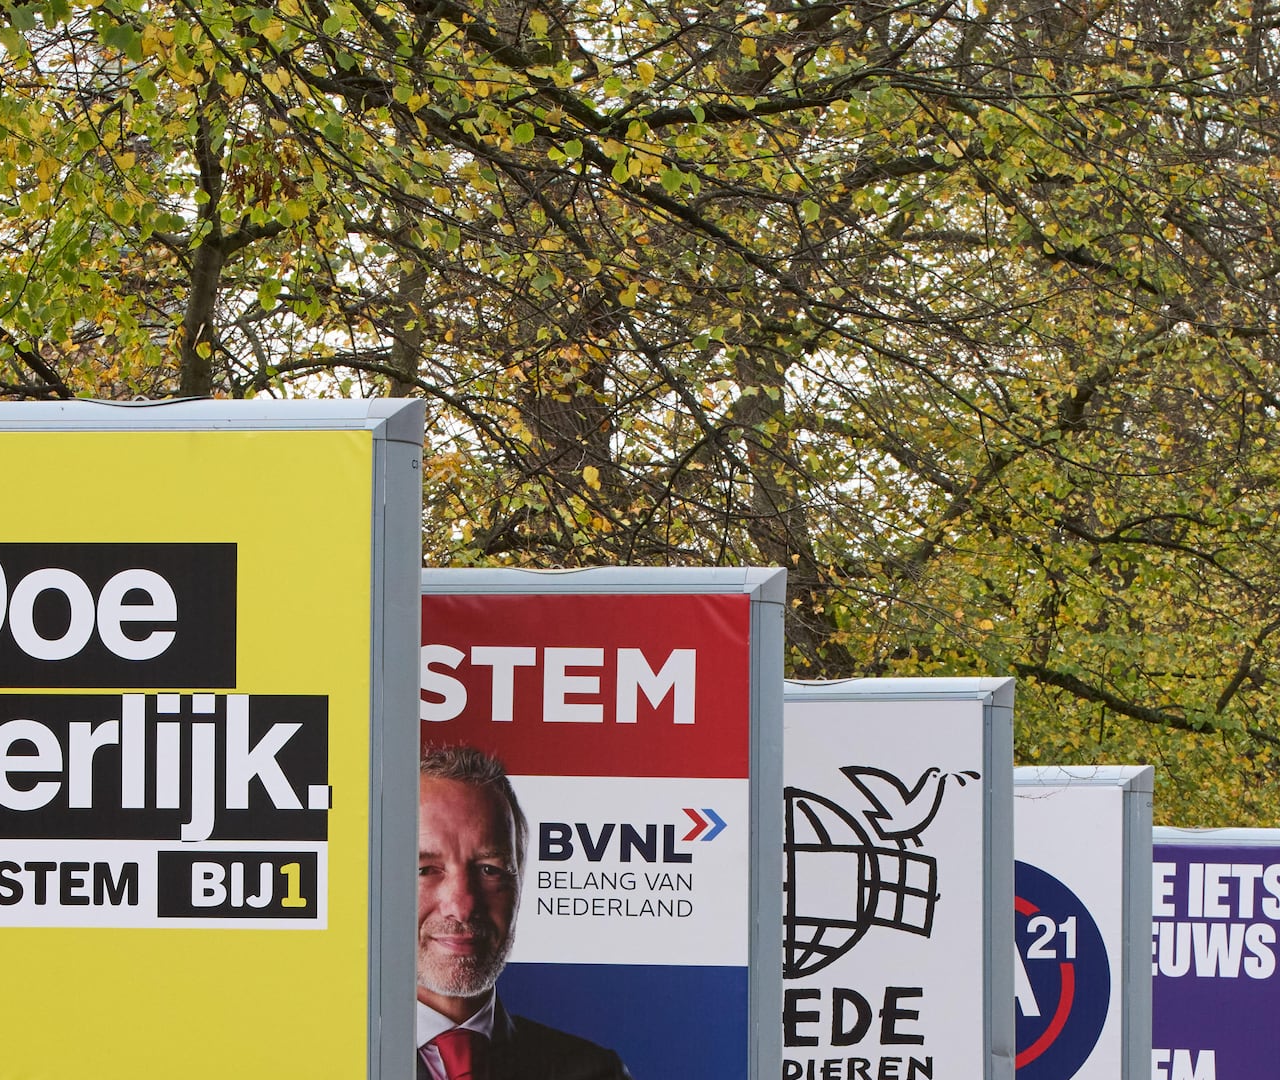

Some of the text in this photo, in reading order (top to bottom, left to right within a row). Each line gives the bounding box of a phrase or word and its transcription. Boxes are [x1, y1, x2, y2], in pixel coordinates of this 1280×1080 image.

[419, 644, 697, 724] STEM
[538, 822, 693, 864] BVNL
[190, 862, 308, 908] BIJ1
[537, 871, 693, 892] BELANG VAN
[537, 897, 694, 918] NEDERLAND
[1152, 922, 1277, 980] UWS
